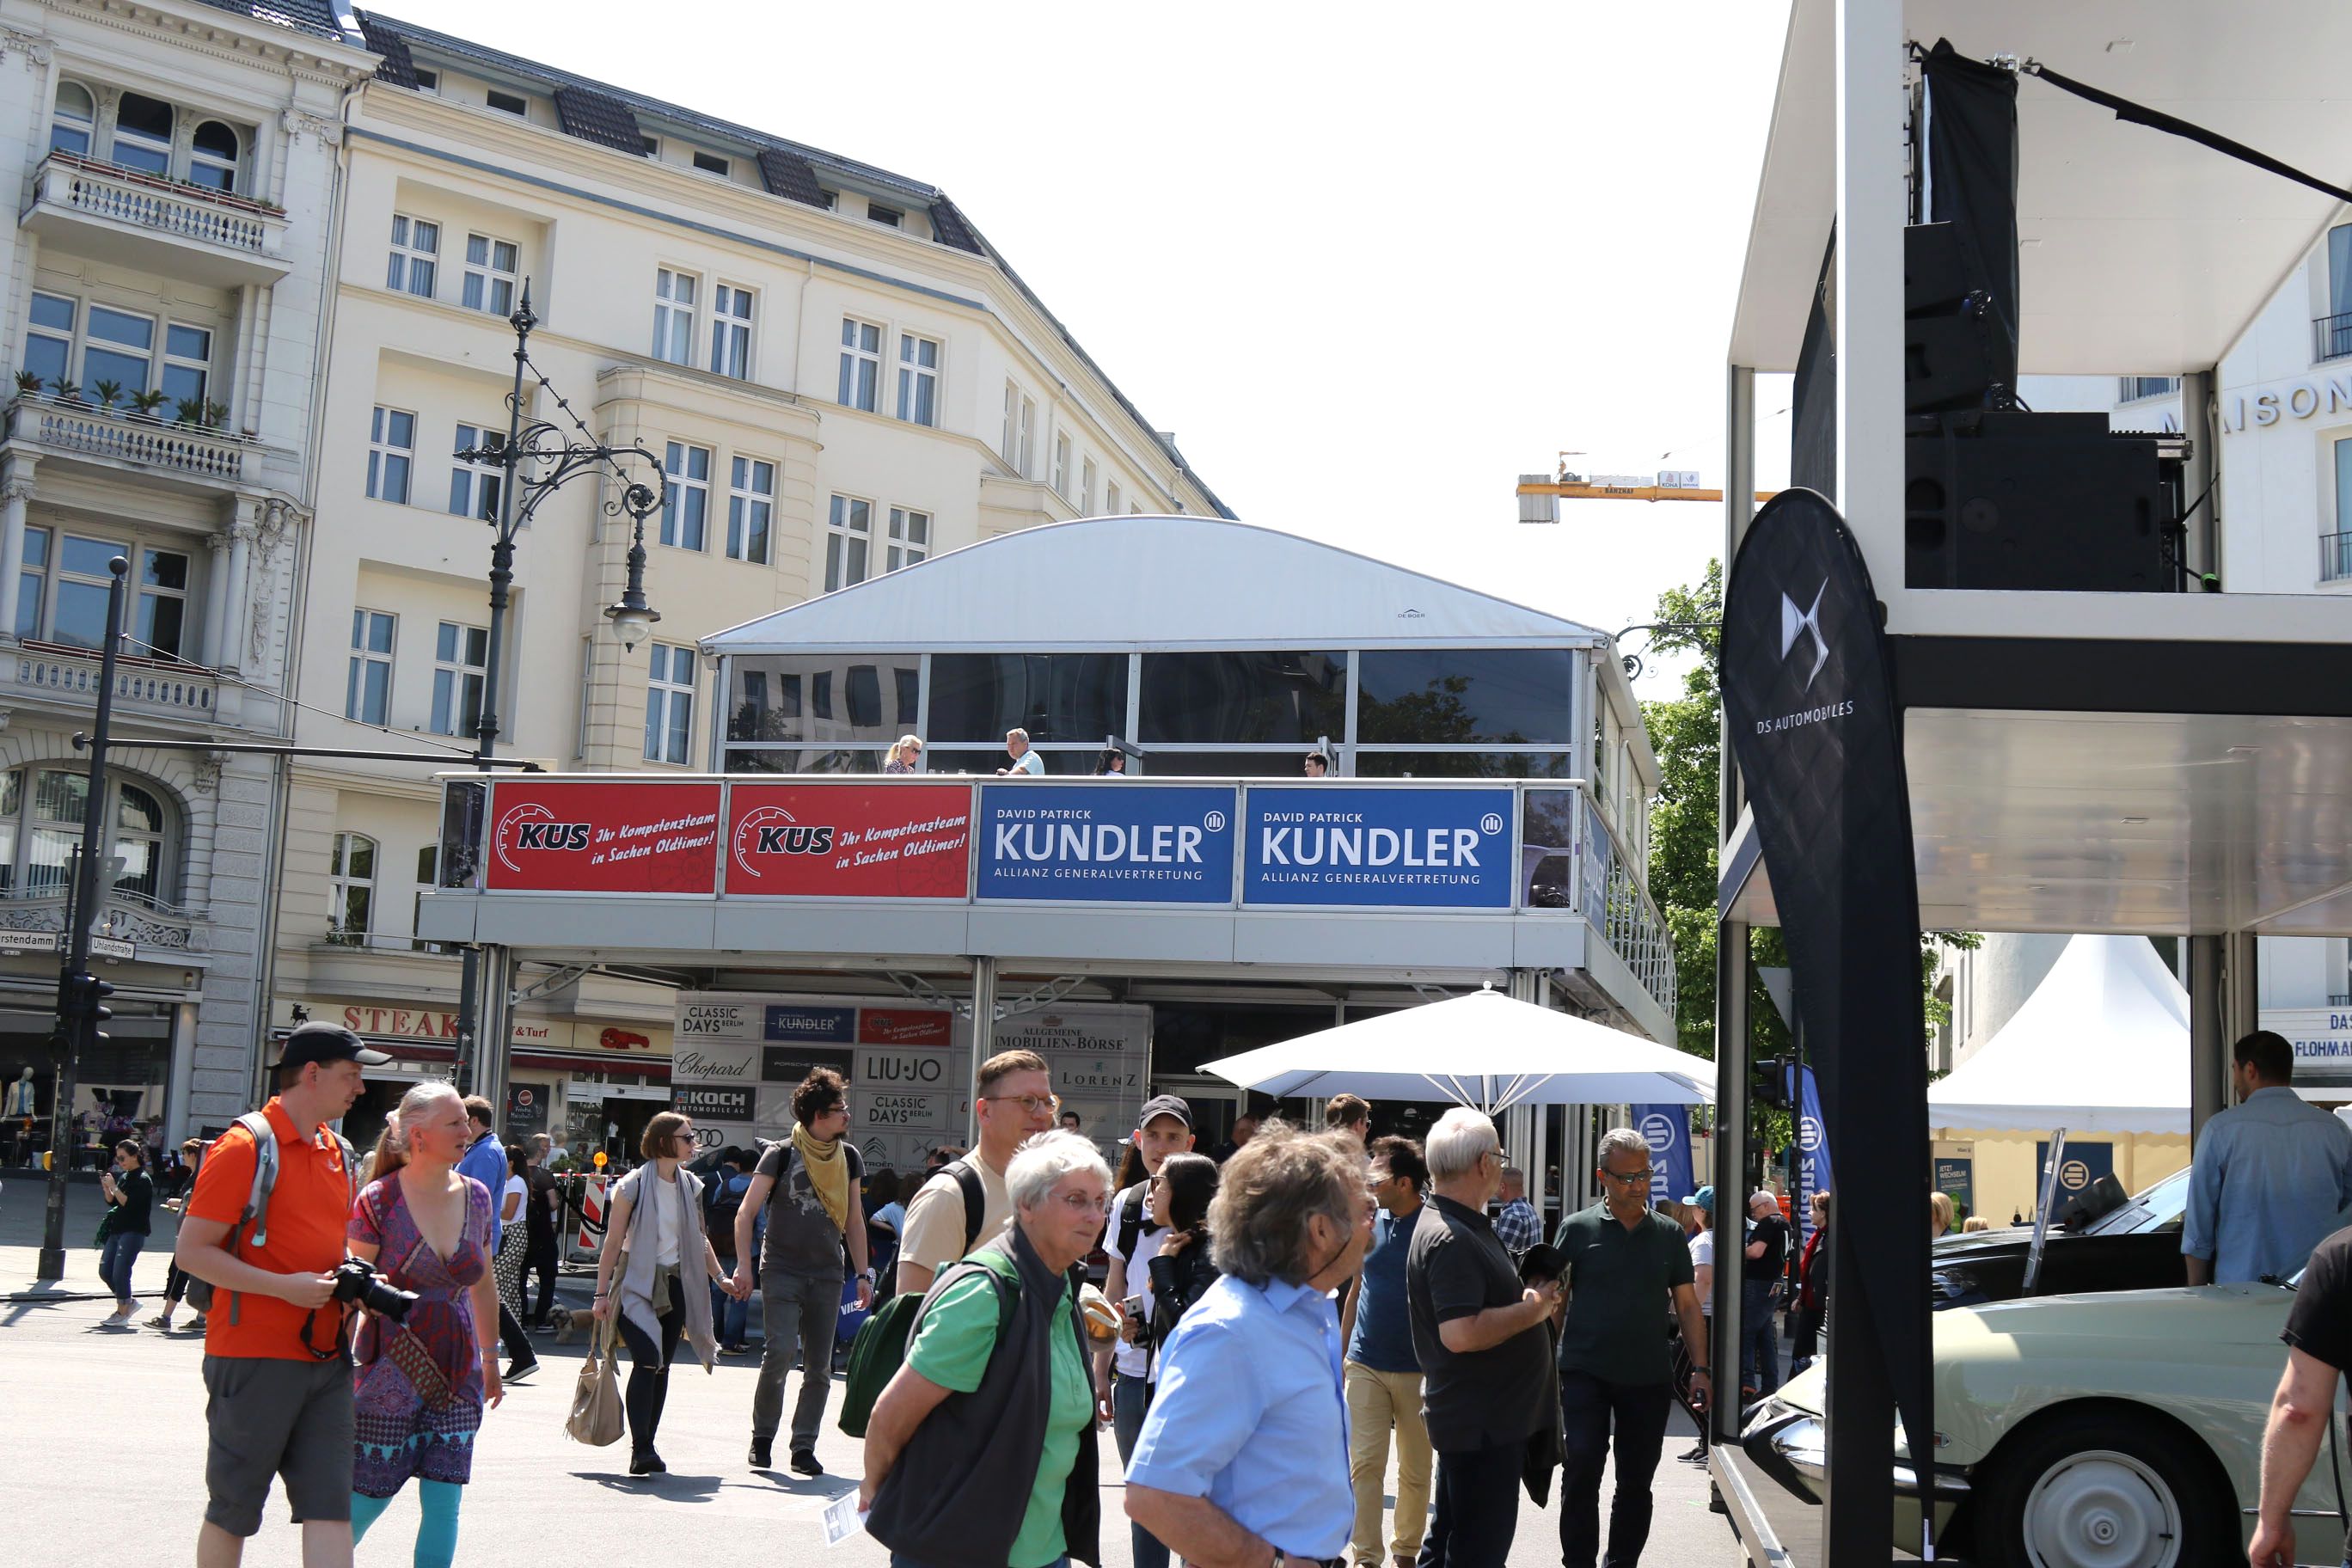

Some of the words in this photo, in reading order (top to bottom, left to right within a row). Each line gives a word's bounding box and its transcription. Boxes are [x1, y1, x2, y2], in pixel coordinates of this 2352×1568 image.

[1757, 720, 1772, 734] DS
[1775, 701, 1853, 731] AUTOMOBILES
[997, 809, 1036, 818] DAVID
[1040, 810, 1092, 819] PATRICK
[1264, 812, 1305, 822] DAVID
[1309, 813, 1363, 823] PATRICK
[595, 827, 616, 843] Ihr
[619, 813, 716, 839] Kompetenzteam
[840, 830, 861, 847] Ihr
[864, 815, 966, 842] Kompetenzteam
[591, 852, 603, 865] in
[608, 844, 651, 862] Sachen
[655, 830, 715, 854] Oldtimer!
[836, 856, 848, 869] in
[853, 849, 898, 866] Sachen
[903, 832, 966, 857] Oldtimer!
[995, 824, 1204, 863] KUNDLER
[1262, 827, 1480, 867] KUNDLER
[994, 867, 1050, 878] ALLIANZ
[1054, 868, 1203, 880] GENERALVERTRETUNG
[1261, 873, 1320, 883] ALLIANZ
[1325, 873, 1480, 885] GENERALVERTRETUNG
[0, 934, 53, 946] rstendamm
[94, 940, 132, 956] Uhlandstraße
[689, 1008, 738, 1019] CLASSIC
[683, 1019, 720, 1032] DAYS
[778, 1018, 835, 1031] KUNDLER
[1022, 1027, 1083, 1037] ALLGEMEINE
[2295, 1041, 2352, 1057] FLOHMA
[674, 1050, 752, 1080] Chopard
[1063, 1072, 1136, 1087] LORENZ
[690, 1092, 745, 1106] KOCH
[875, 1097, 927, 1109] CLASSIC
[869, 1109, 909, 1124] DAYS
